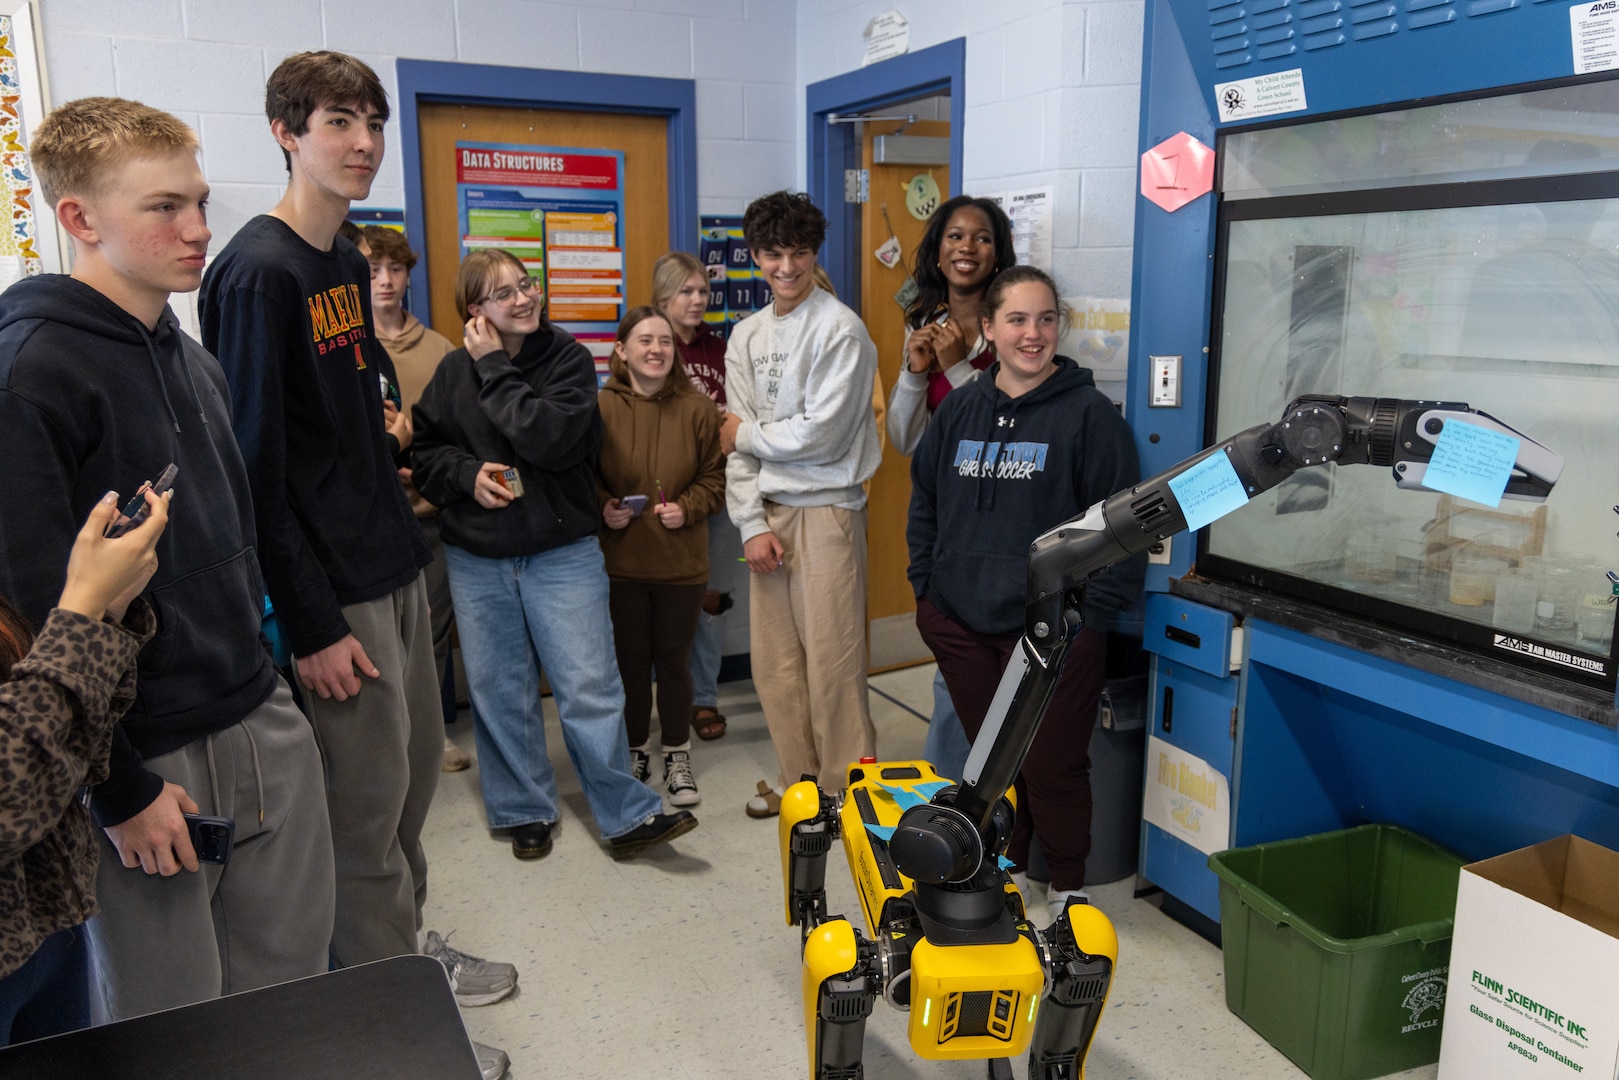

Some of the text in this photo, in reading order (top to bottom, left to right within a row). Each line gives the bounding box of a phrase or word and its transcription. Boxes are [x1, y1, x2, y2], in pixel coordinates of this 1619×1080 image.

[1589, 1, 1616, 12] AMS
[1262, 84, 1280, 92] Calvert
[1281, 80, 1301, 89] County
[1265, 76, 1279, 84] Child
[1281, 71, 1301, 80] Attends
[1274, 90, 1291, 98] School
[463, 150, 564, 172] DATA STRUCTURES
[1156, 153, 1188, 191] 1
[708, 250, 722, 263] 04
[733, 248, 748, 262] 05
[737, 289, 750, 304] 11
[1533, 645, 1545, 656] AIR
[1545, 648, 1571, 664] MASTER
[1572, 655, 1604, 672] SYSTEMS
[1158, 752, 1177, 791] Fire
[1472, 970, 1503, 995] FLINN
[1505, 988, 1565, 1028] SCIENTIFIC
[1567, 1019, 1588, 1042] INC.
[1487, 992, 1503, 1004] Safer
[1503, 1001, 1524, 1015] Source
[1534, 1018, 1558, 1034] Science
[1401, 1019, 1439, 1034] RECYCLE
[1470, 1004, 1584, 1073] Glass Disposal Container
[1508, 1041, 1538, 1063] AP8830
